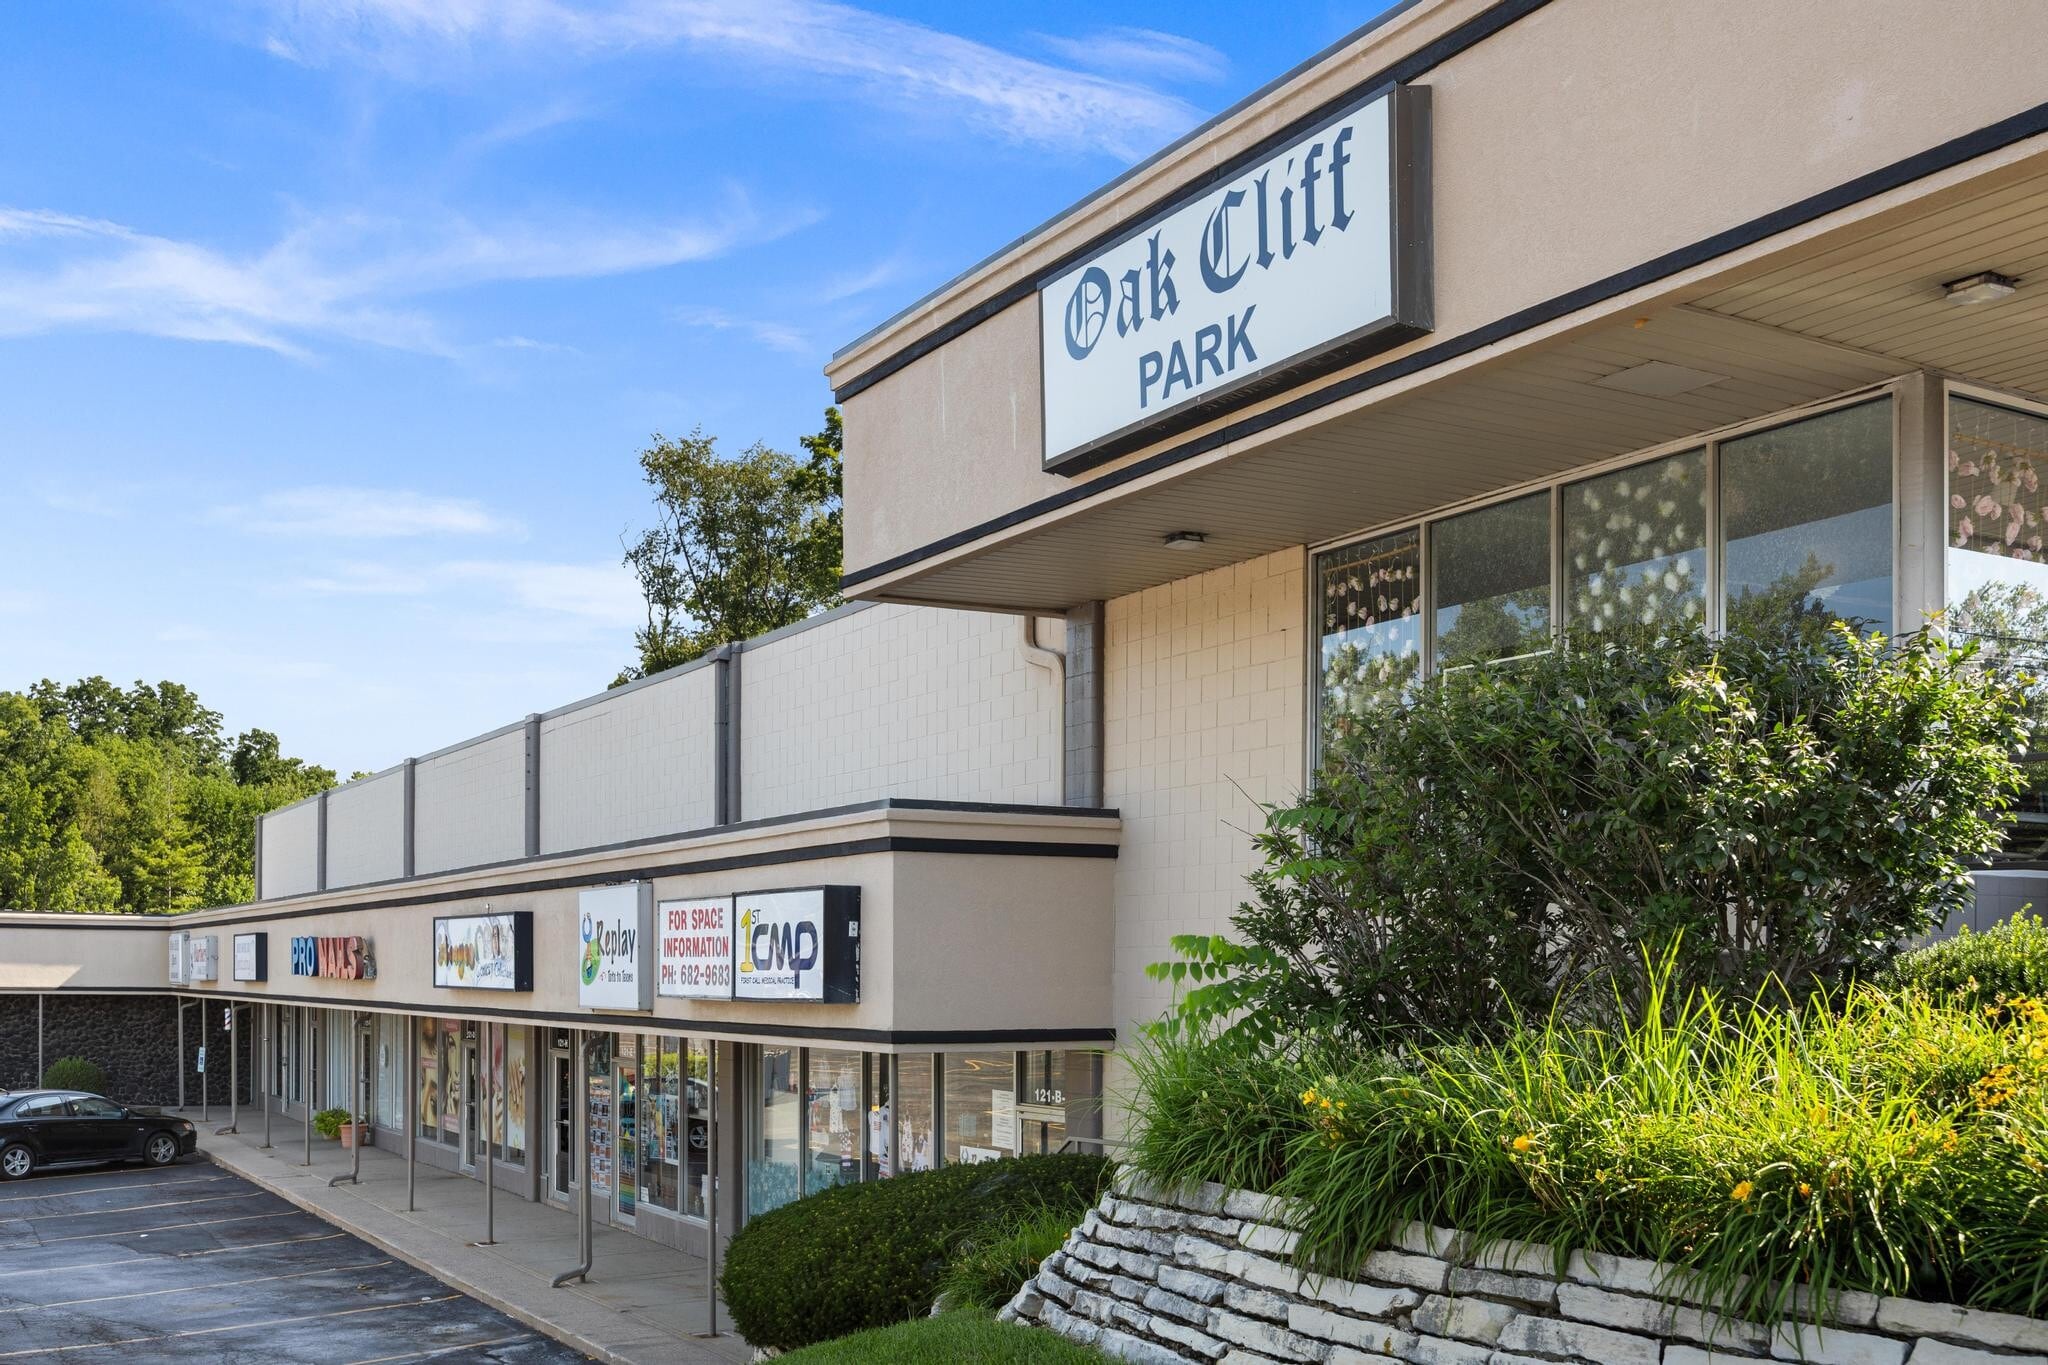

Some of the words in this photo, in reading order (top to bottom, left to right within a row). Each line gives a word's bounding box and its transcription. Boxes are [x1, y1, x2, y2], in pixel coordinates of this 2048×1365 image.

[1064, 229, 1181, 361] Oak
[1200, 126, 1355, 294] Cliff
[1138, 304, 1259, 409] PARK
[596, 918, 636, 965] Replay
[668, 910, 687, 931] FOR
[692, 907, 724, 930] SPACE
[291, 935, 316, 977] PRO
[318, 936, 361, 980] NAILS
[663, 936, 729, 958] INFORMATION
[661, 964, 677, 985] PH:
[680, 964, 730, 986] 682-9683
